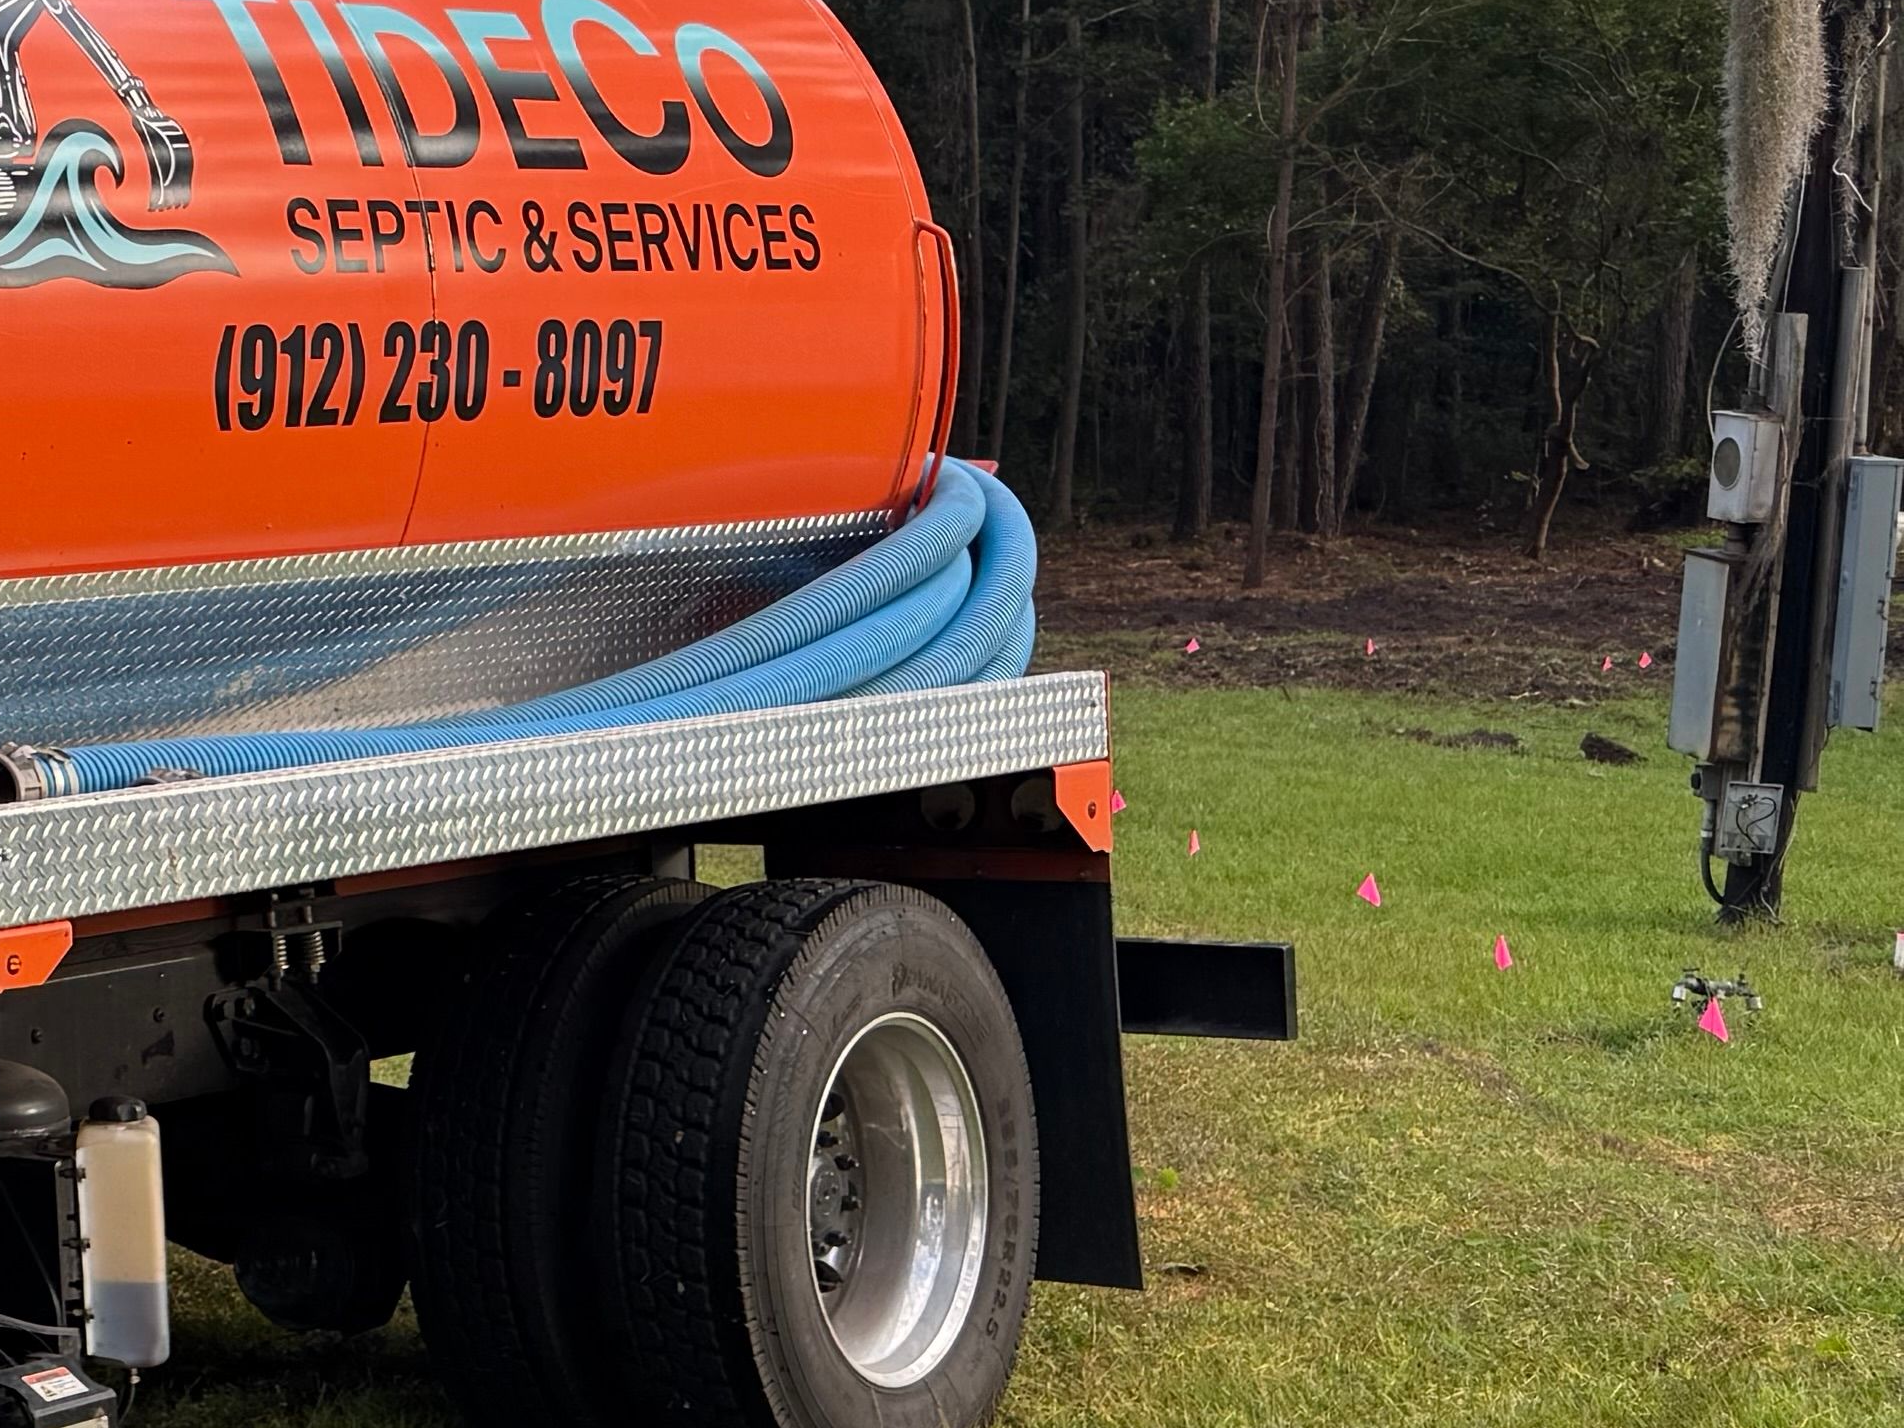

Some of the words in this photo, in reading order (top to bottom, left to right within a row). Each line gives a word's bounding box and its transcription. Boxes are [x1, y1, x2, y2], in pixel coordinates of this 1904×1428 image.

[285, 197, 507, 276] SEPTIC
[523, 200, 562, 273] &
[571, 201, 822, 275] SERVICES
[214, 321, 366, 434] (912)
[379, 320, 491, 425] 230
[533, 319, 664, 421] 8097
